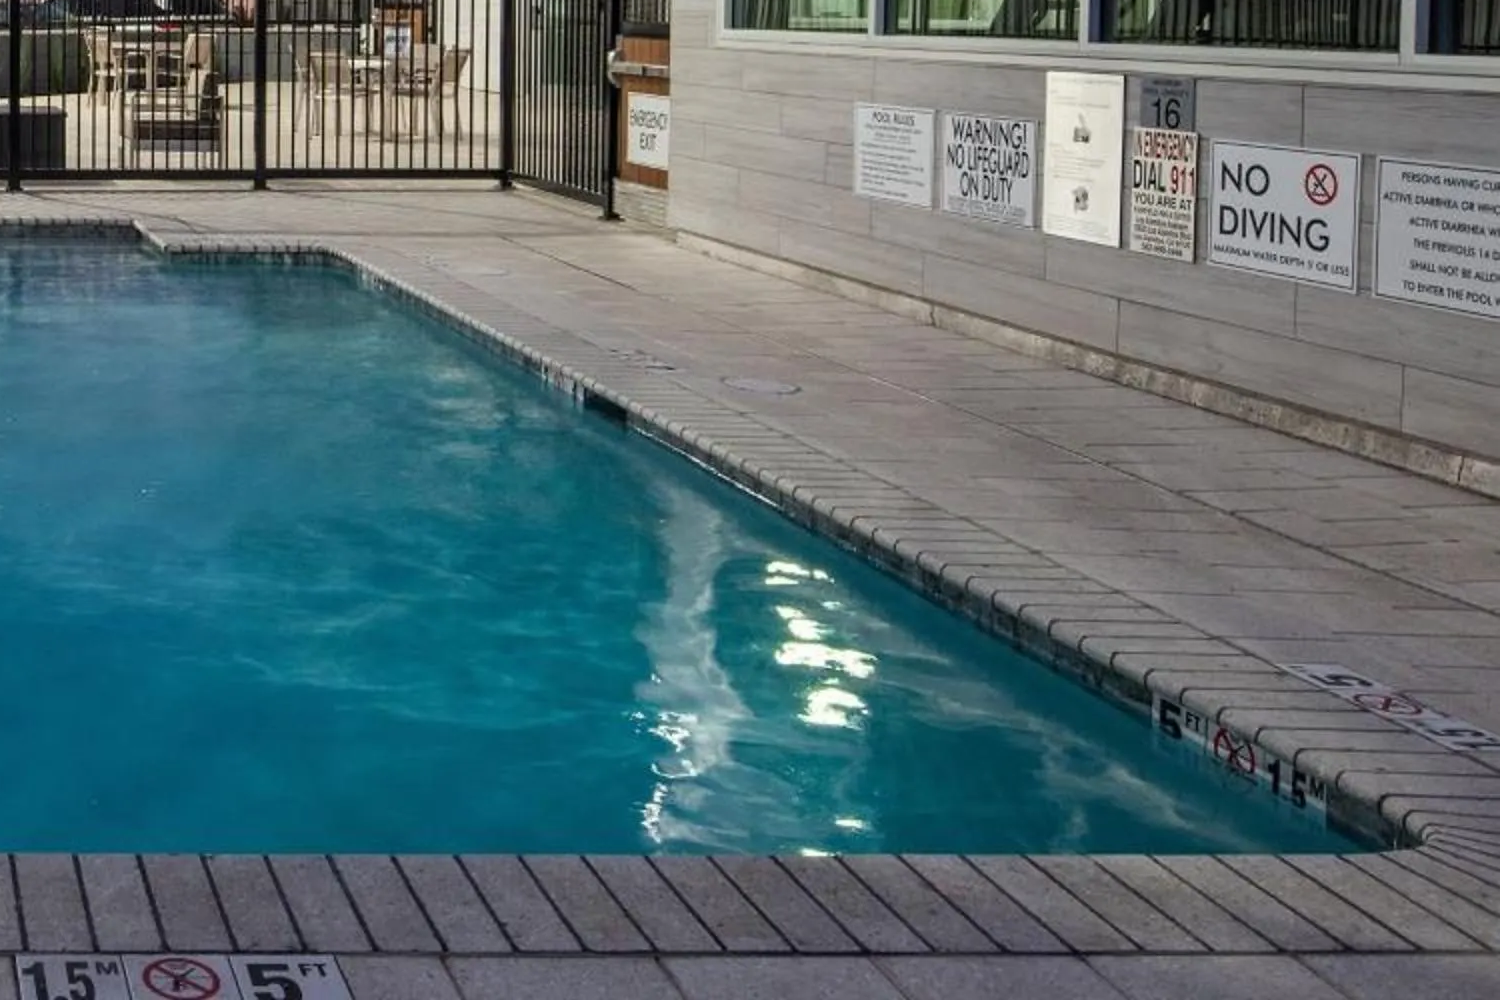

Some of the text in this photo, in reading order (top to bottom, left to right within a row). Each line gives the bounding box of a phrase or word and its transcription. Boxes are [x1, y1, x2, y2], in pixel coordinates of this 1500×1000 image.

[1151, 97, 1181, 129] 16
[951, 116, 1027, 150] WARNING!
[946, 143, 964, 168] NO
[967, 145, 1029, 179] LIFEGUARD
[960, 171, 1012, 204] ON DUTY
[1133, 159, 1166, 193] DIAL
[1170, 165, 1195, 198] 911
[1221, 160, 1270, 197] NO
[1402, 171, 1441, 185] PERSONS
[1219, 204, 1330, 252] DIVING
[1409, 217, 1439, 230] ACTIVE
[1413, 238, 1430, 250] THE
[1409, 259, 1436, 273] SHALL
[1438, 264, 1459, 277] NOT
[1403, 279, 1415, 291] TO
